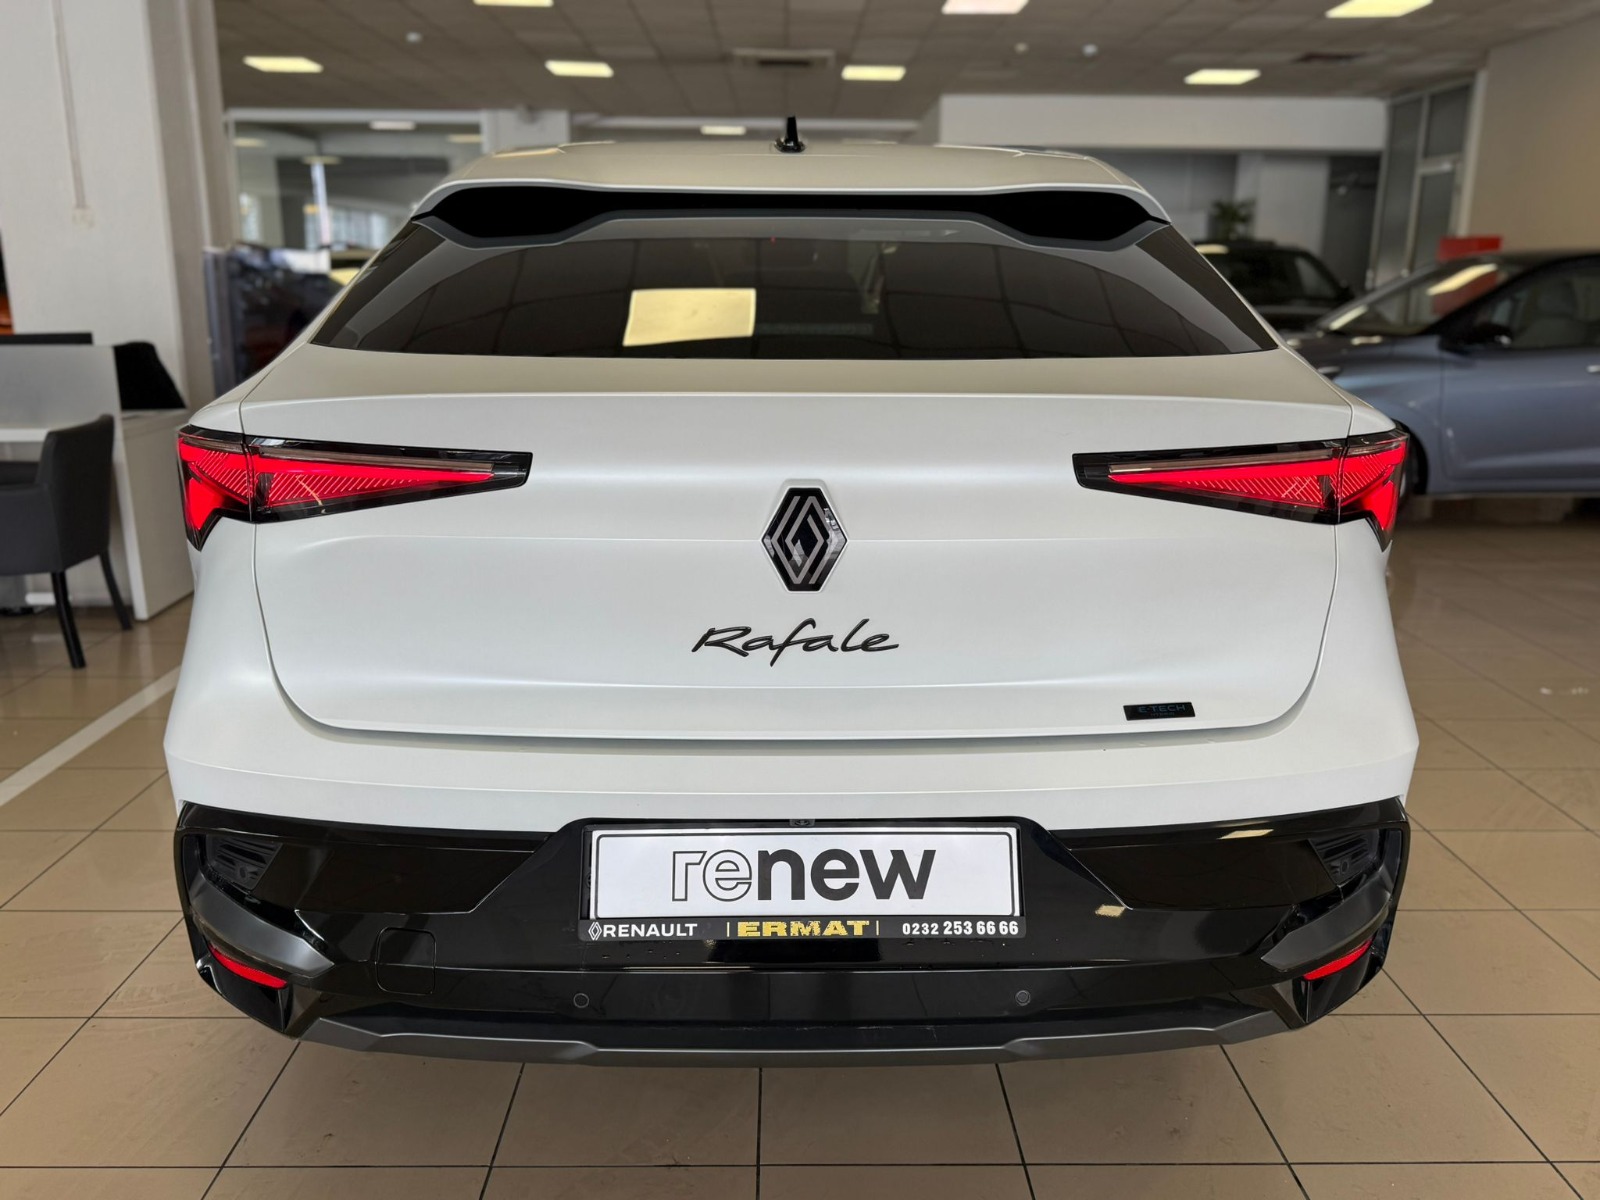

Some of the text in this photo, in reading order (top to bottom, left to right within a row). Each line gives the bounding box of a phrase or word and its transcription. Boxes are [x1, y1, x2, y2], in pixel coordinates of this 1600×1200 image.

[691, 617, 899, 667] Rafale
[672, 848, 936, 902] renew
[603, 920, 1019, 938] RENAULT ERMAT 0232 253 66 66
